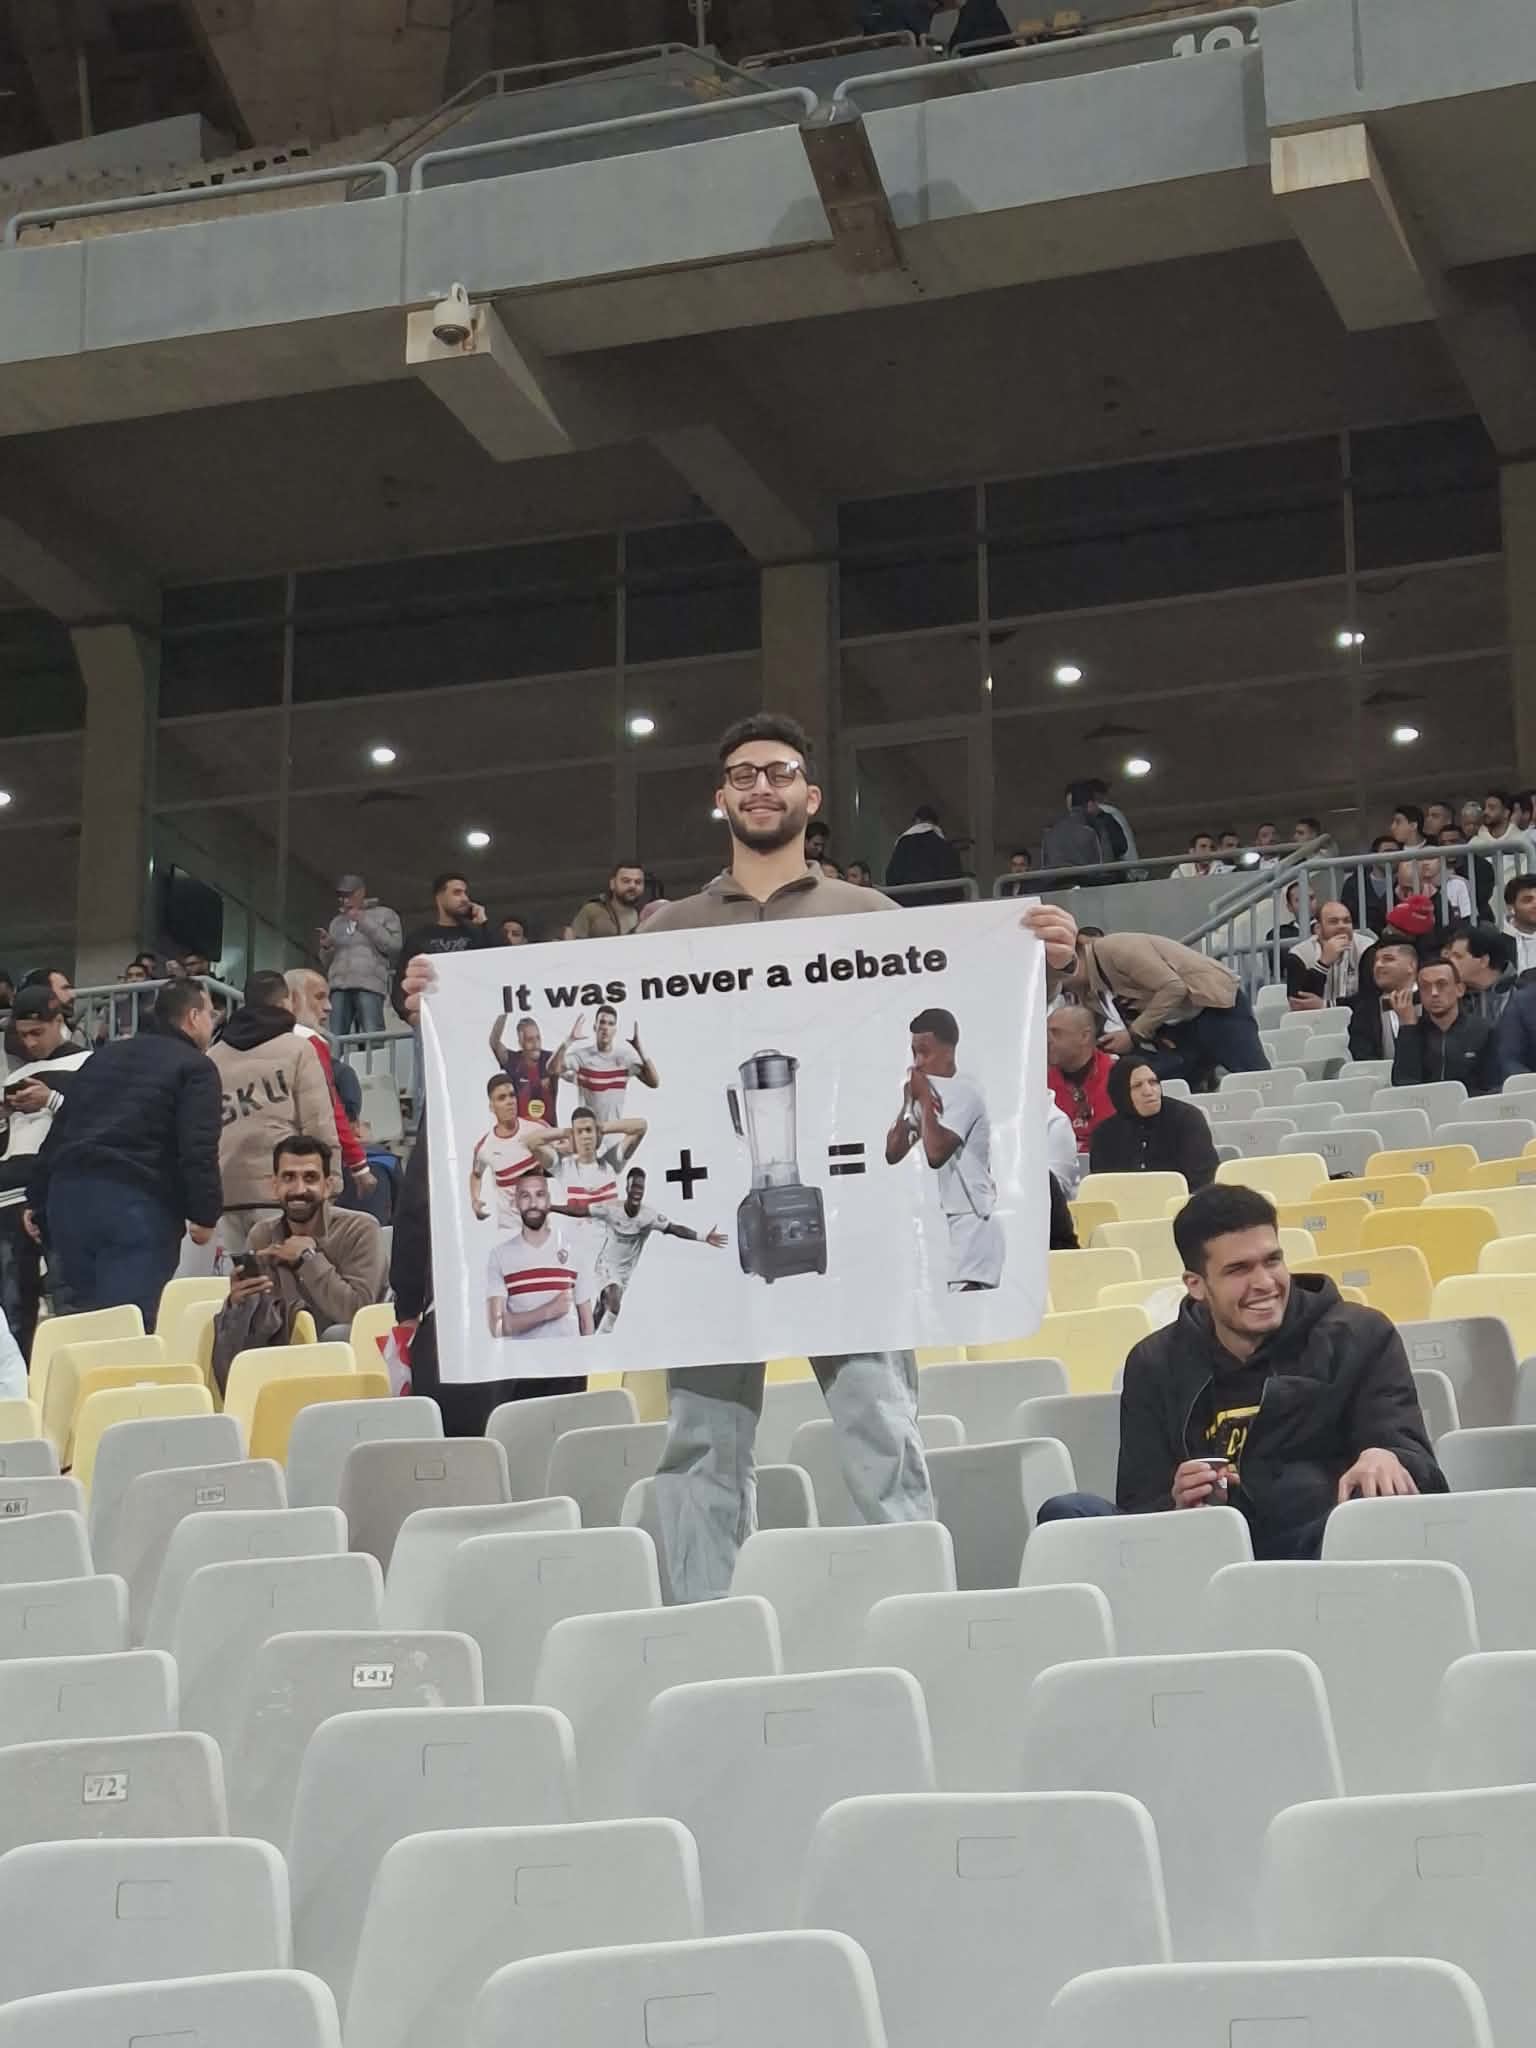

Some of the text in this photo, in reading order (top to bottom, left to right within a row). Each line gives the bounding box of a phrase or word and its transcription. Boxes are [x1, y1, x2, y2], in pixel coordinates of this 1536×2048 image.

[502, 945, 948, 1013] It was never a debate
[93, 1777, 117, 1797] 72
